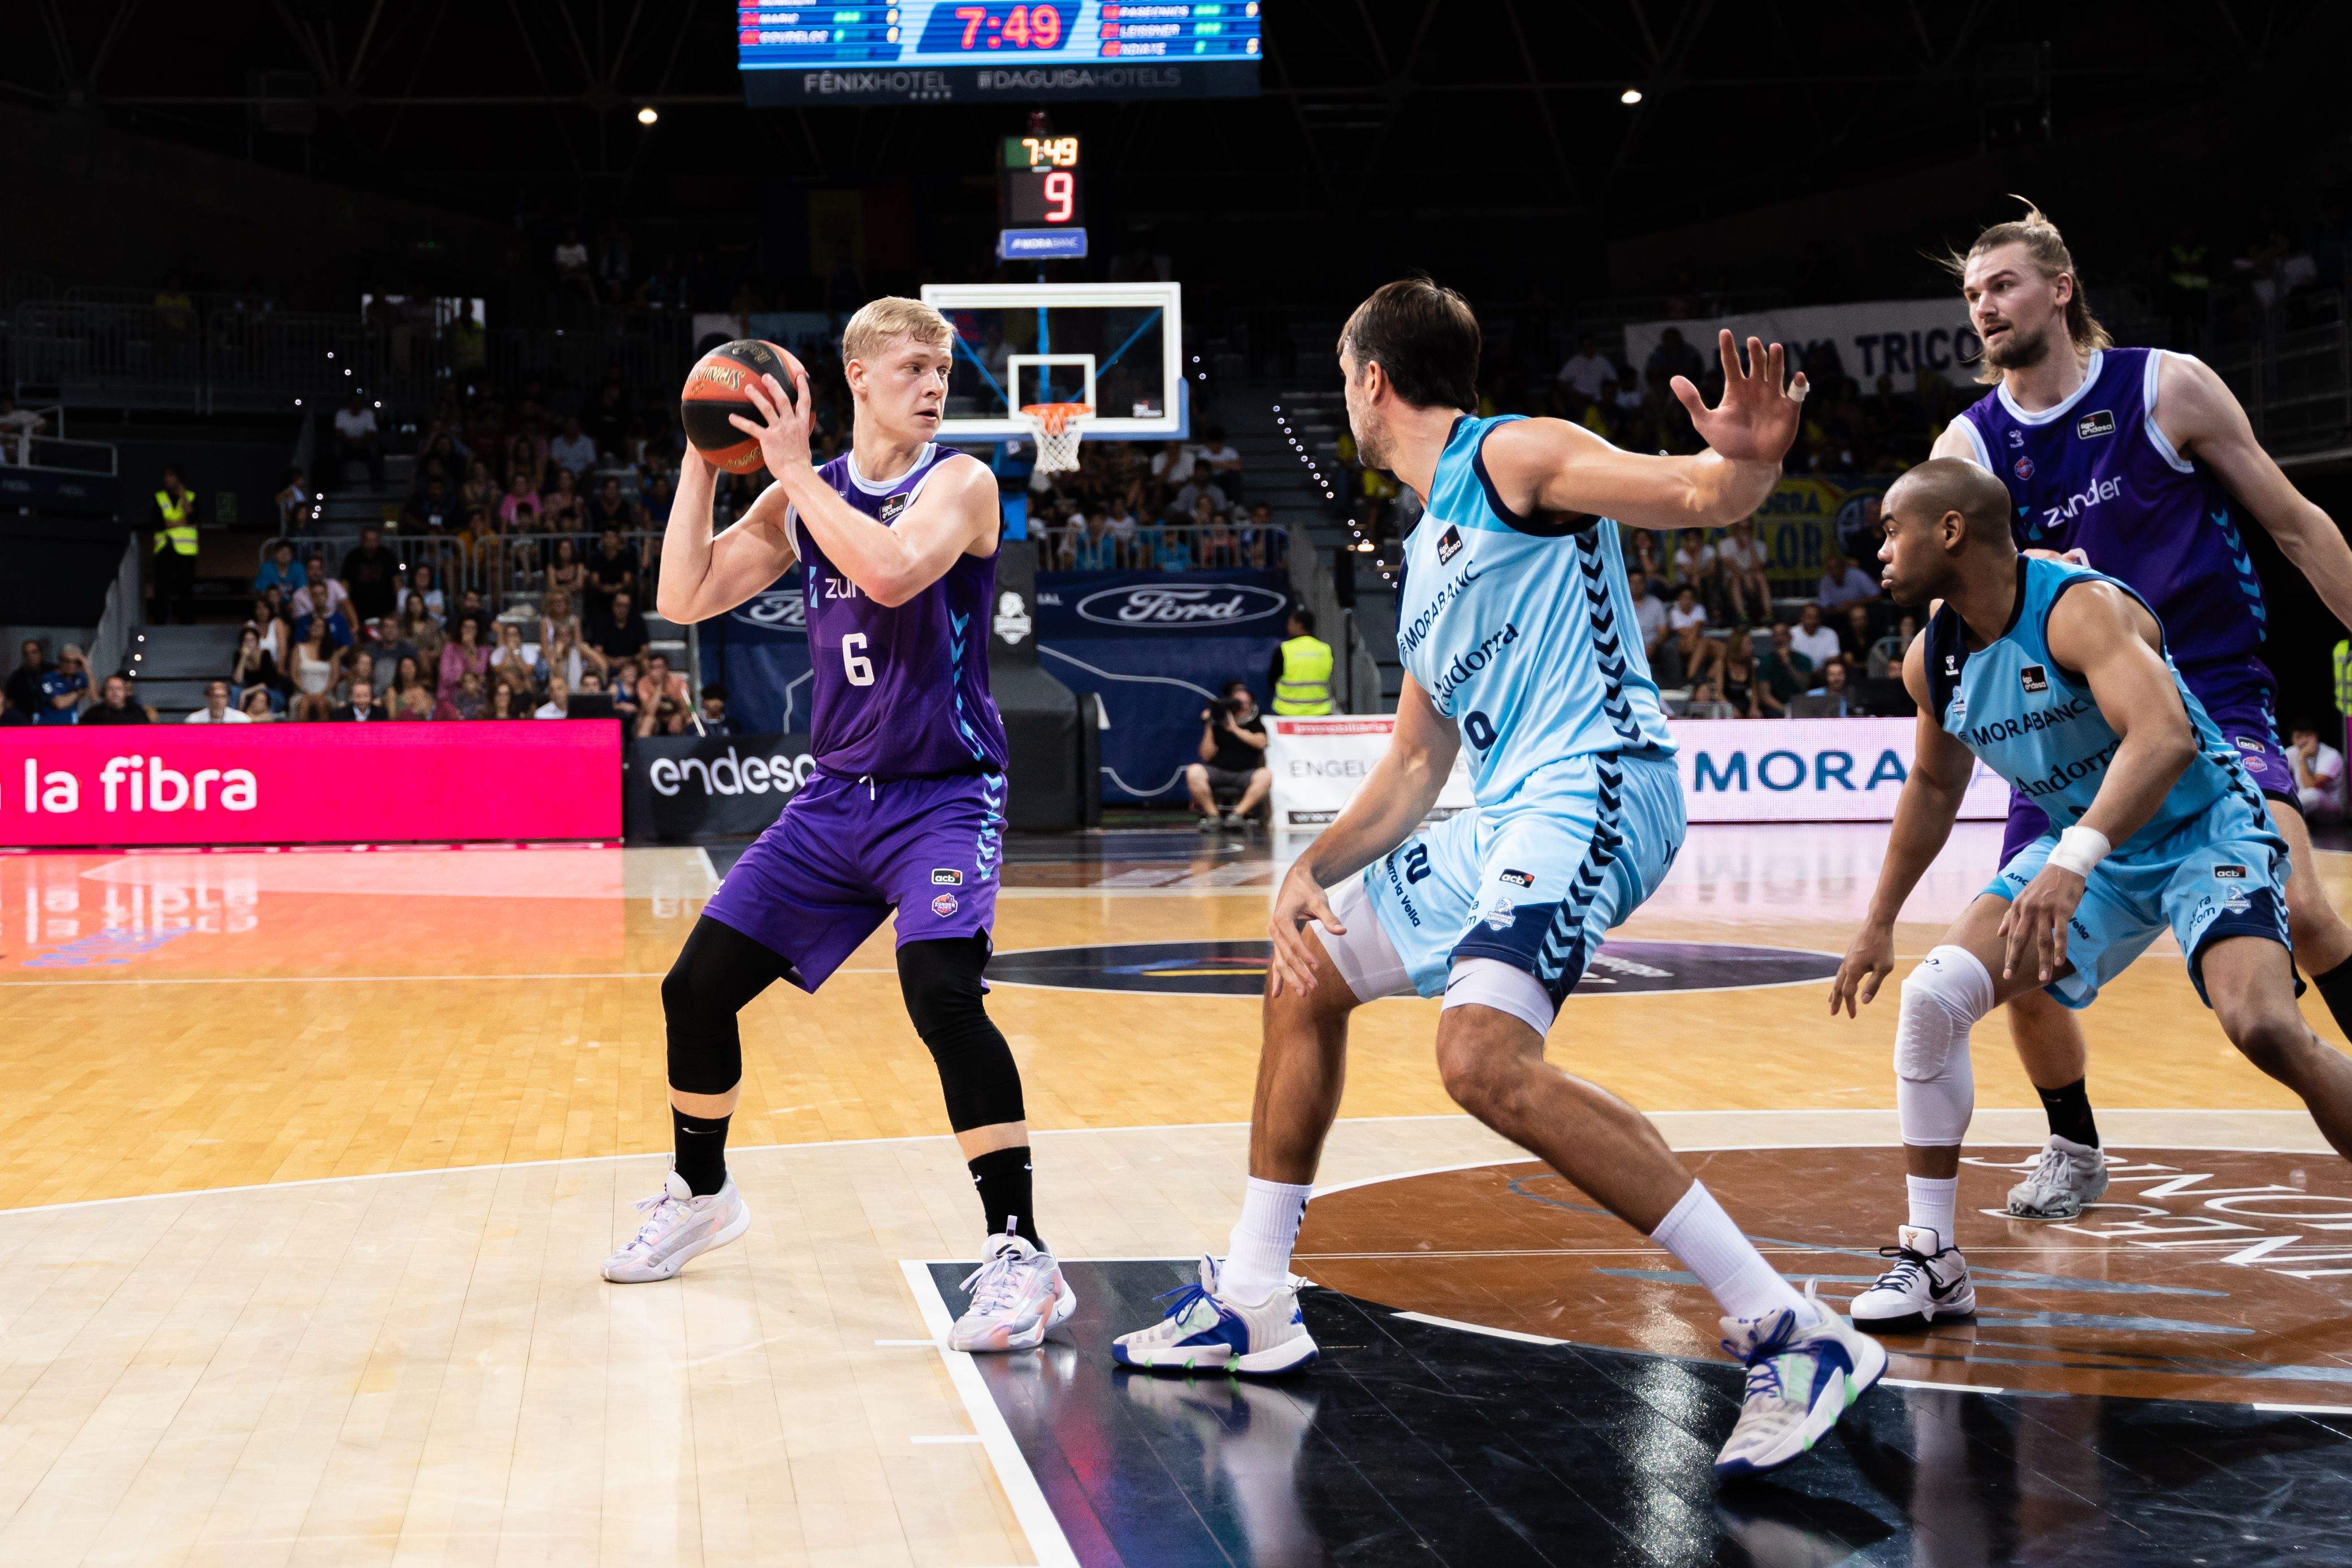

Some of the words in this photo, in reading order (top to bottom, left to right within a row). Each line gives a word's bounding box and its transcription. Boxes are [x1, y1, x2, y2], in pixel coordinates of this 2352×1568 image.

[955, 3, 1062, 50] 7:49
[1023, 138, 1078, 166] 7:49
[1045, 172, 1074, 222] 9
[1855, 326, 1983, 375] TRICO
[882, 504, 903, 519] endesa
[2043, 475, 2121, 528] zunder
[1442, 540, 1462, 562] endesa
[1117, 590, 1245, 622] Ford
[1405, 560, 1482, 652] MORABANC
[842, 633, 875, 686] 6
[1972, 698, 2089, 747] MORABANC
[25, 758, 79, 813] la
[99, 754, 258, 812] fibra
[1501, 874, 1525, 885] acb
[1394, 881, 1404, 897] la
[1401, 894, 1421, 928] Vella
